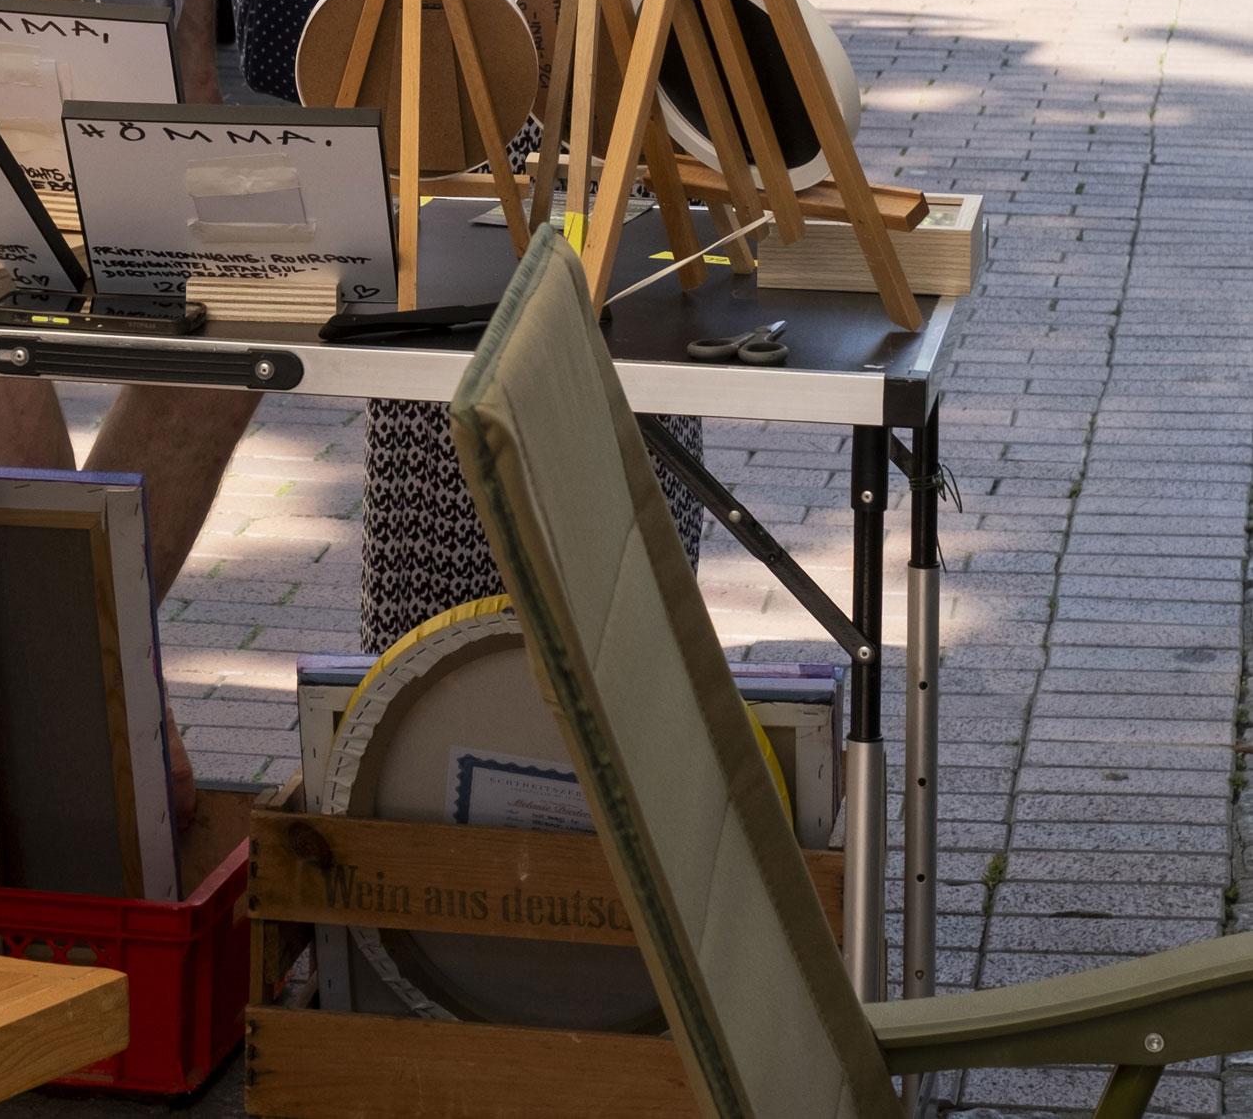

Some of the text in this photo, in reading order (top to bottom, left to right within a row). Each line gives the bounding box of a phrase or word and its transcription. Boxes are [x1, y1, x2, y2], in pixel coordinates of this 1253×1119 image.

[321, 863, 634, 933] Wein aus deutsc
